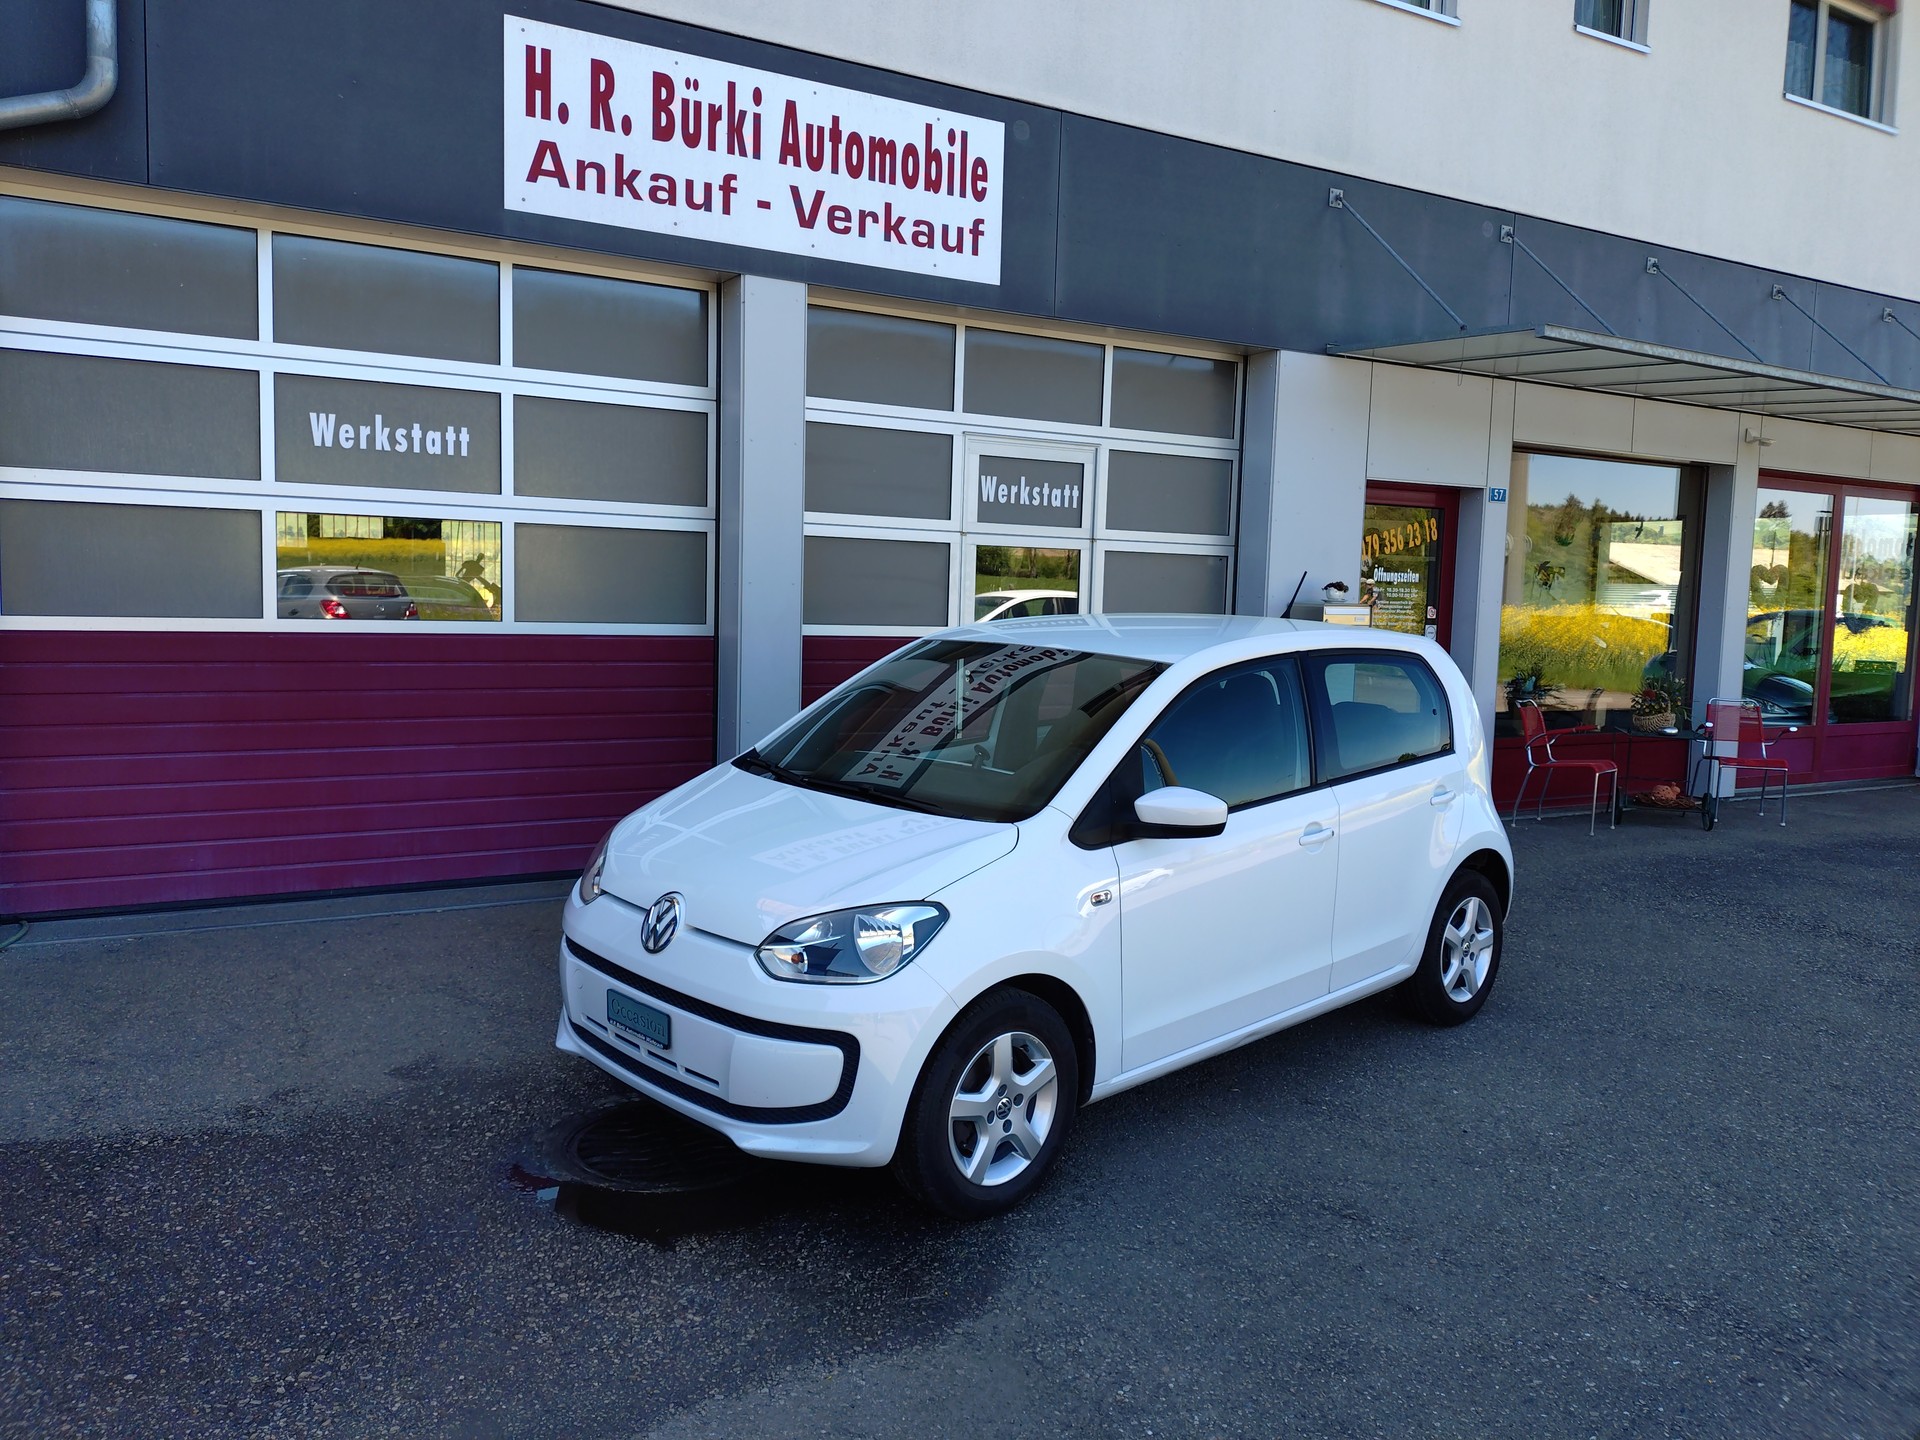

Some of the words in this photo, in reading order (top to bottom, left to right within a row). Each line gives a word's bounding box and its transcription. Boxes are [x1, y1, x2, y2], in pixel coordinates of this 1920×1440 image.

[525, 44, 570, 125] H.
[590, 58, 633, 136] R.
[652, 70, 762, 160] Bürki
[779, 99, 989, 203] Automobile
[526, 139, 739, 216] Ankauf
[757, 199, 772, 210] -
[790, 184, 985, 257] Verkauf
[309, 412, 470, 457] Werkstatt
[981, 475, 1079, 509] Werkstatt
[1494, 489, 1504, 500] 57
[1383, 527, 1404, 555] 356
[1407, 521, 1422, 548] 23
[1424, 517, 1438, 543] 18
[1373, 564, 1420, 585] Öffnungszeiten
[611, 998, 665, 1038] Occasion
